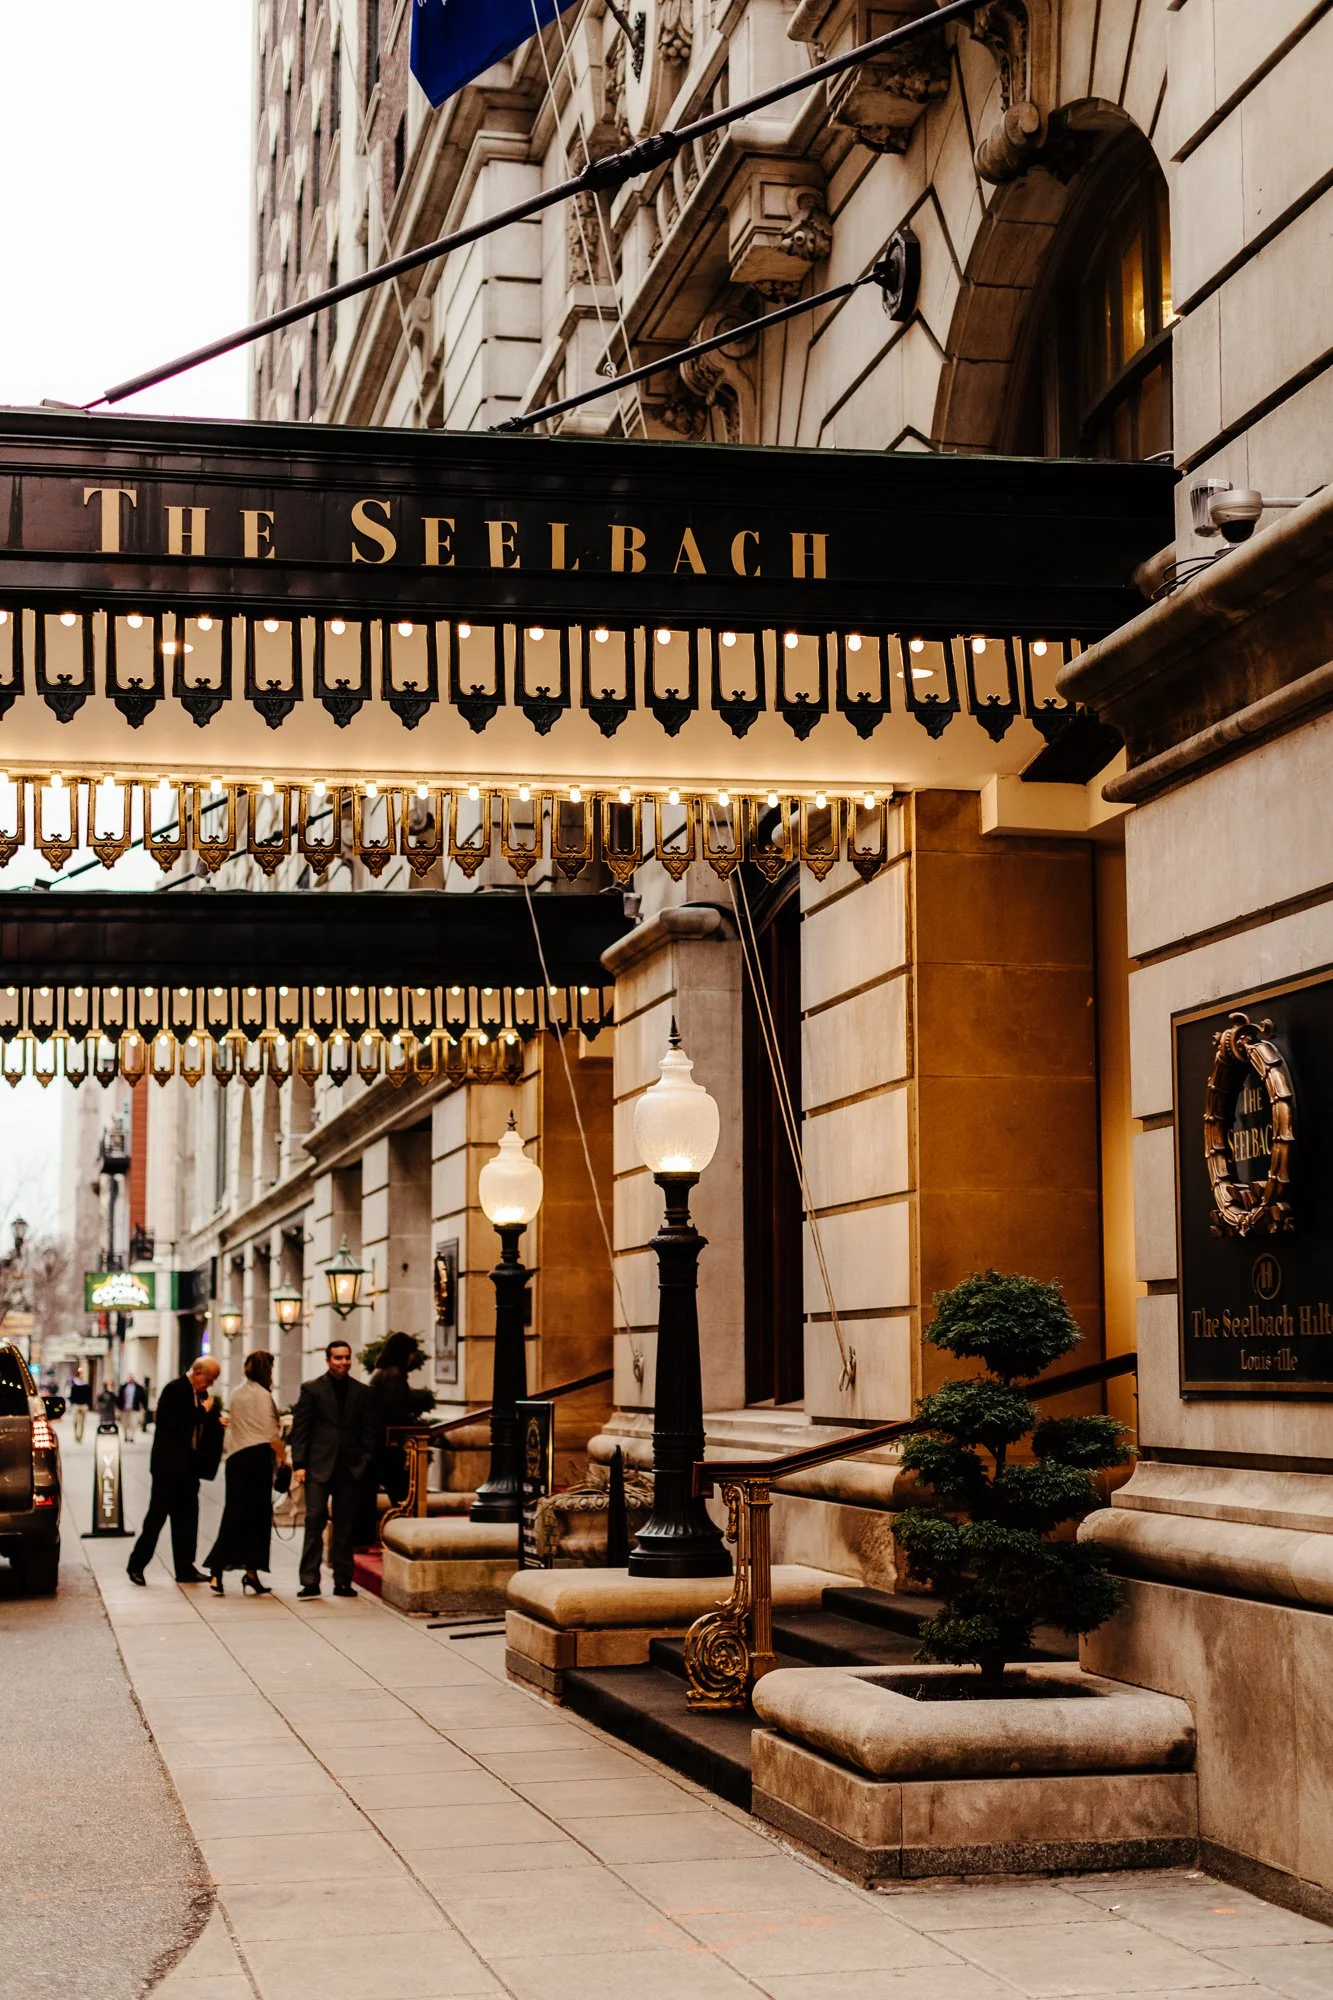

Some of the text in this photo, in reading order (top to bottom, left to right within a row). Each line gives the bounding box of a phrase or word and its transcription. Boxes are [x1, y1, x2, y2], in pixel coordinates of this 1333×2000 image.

[83, 486, 830, 580] THE SEELBACH
[1243, 1086, 1263, 1115] THE
[1227, 1123, 1273, 1163] SEELBAC
[1192, 1307, 1220, 1338] The
[1222, 1304, 1295, 1338] Seelbach
[102, 1454, 115, 1518] VALET
